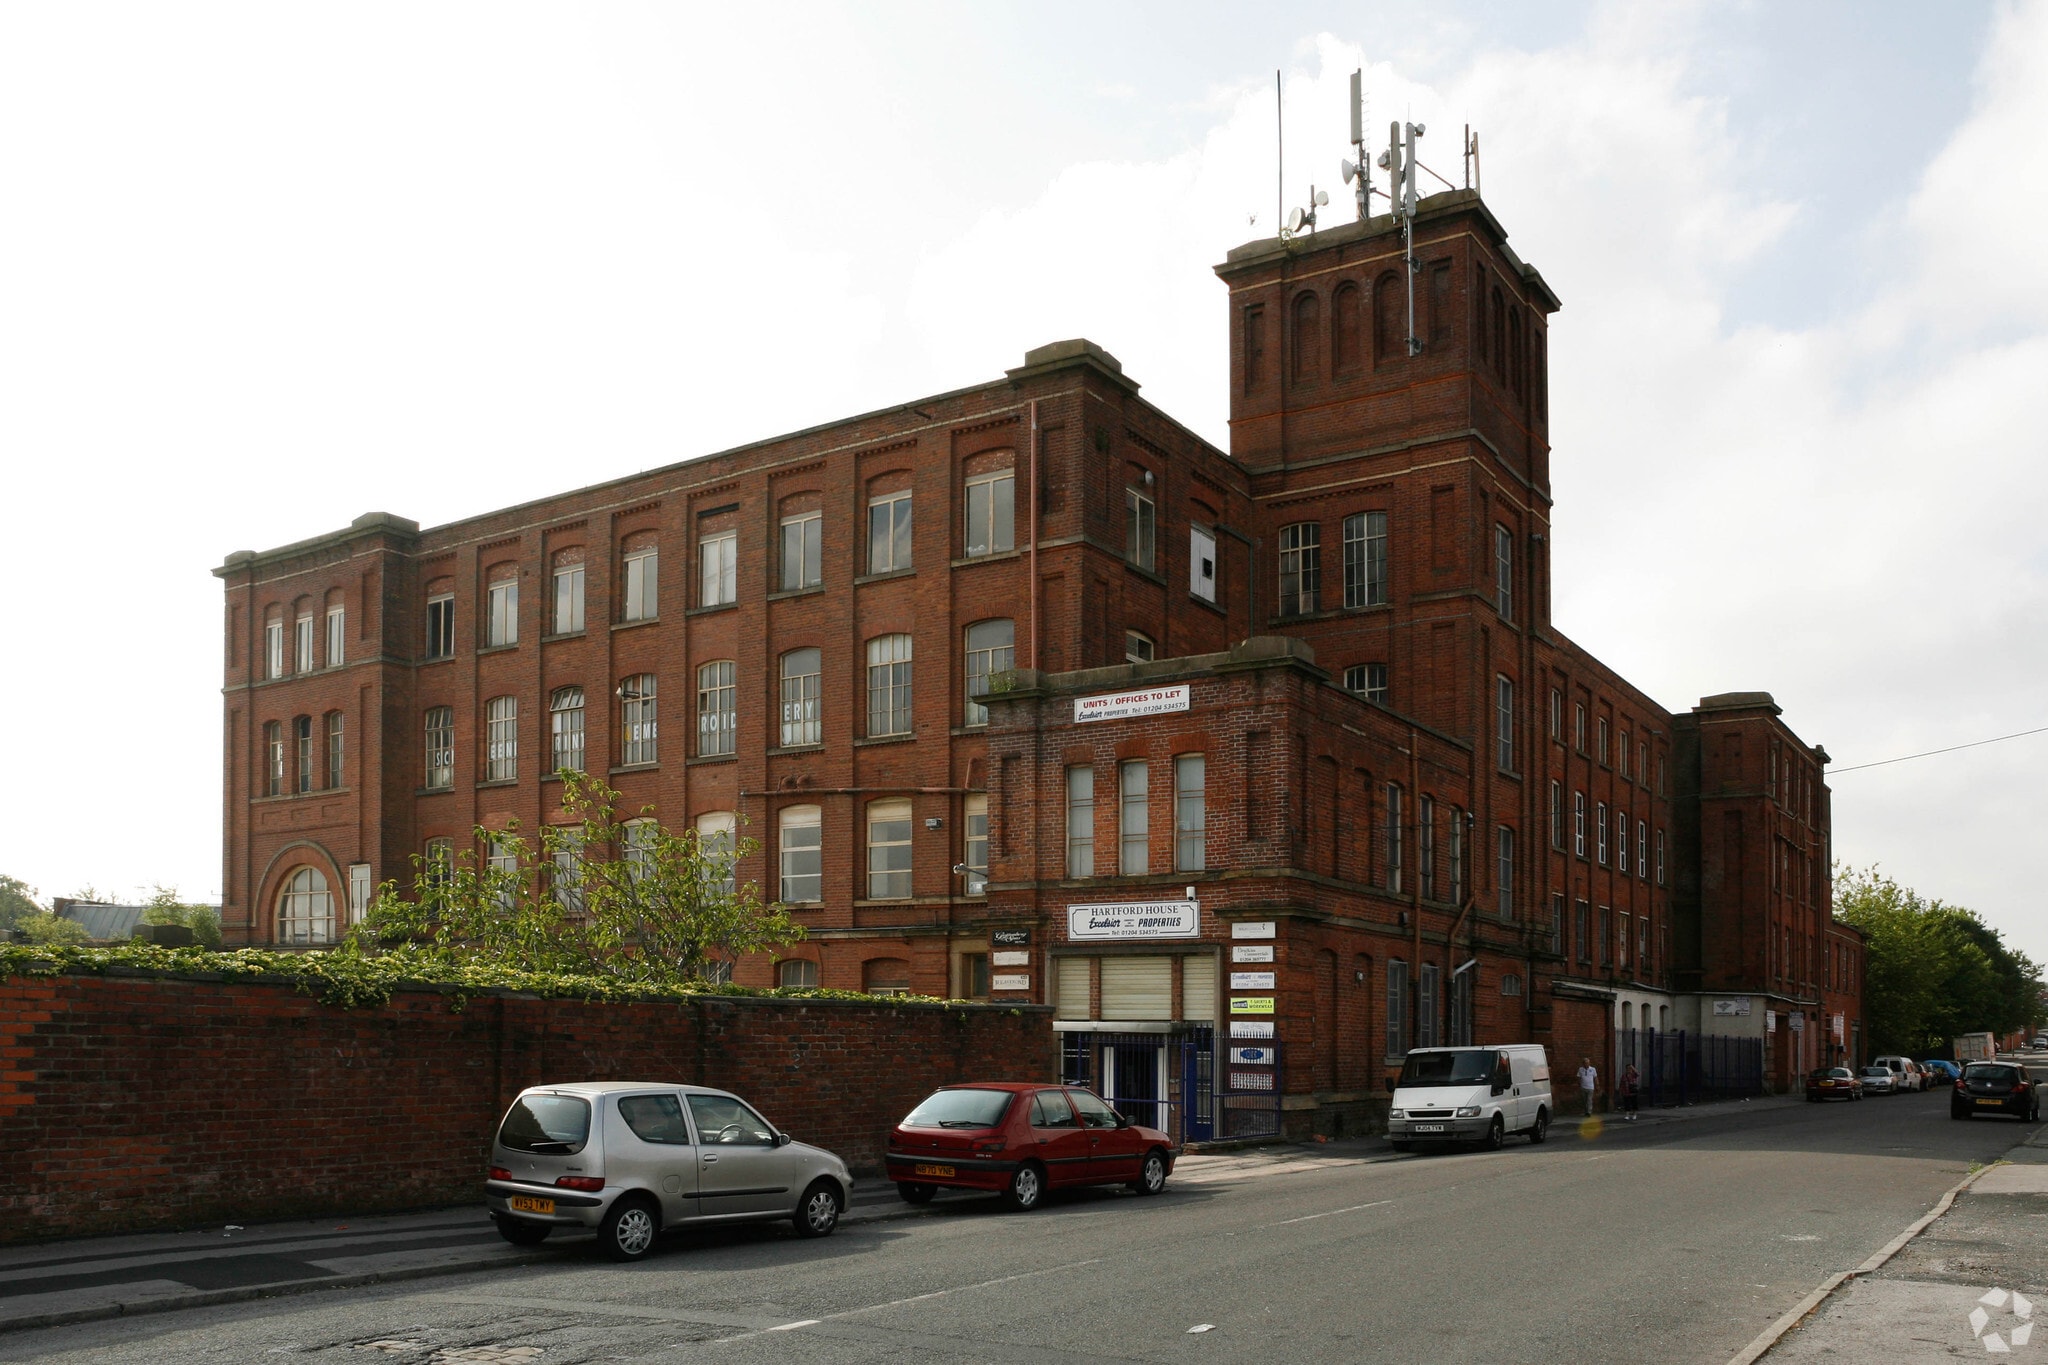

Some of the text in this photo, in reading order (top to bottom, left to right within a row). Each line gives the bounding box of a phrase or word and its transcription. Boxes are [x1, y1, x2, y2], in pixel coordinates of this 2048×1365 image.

[1083, 699, 1108, 709] UNITS
[1115, 694, 1149, 705] OFFICES
[1151, 692, 1163, 701] TO
[1165, 690, 1181, 699] LET
[784, 701, 813, 721] ERY
[1091, 905, 1179, 917] HARTFORD HOUSE
[1089, 917, 1121, 930] Excelsior
[1138, 917, 1181, 928] PROPERTIES
[937, 1165, 954, 1176] YNE
